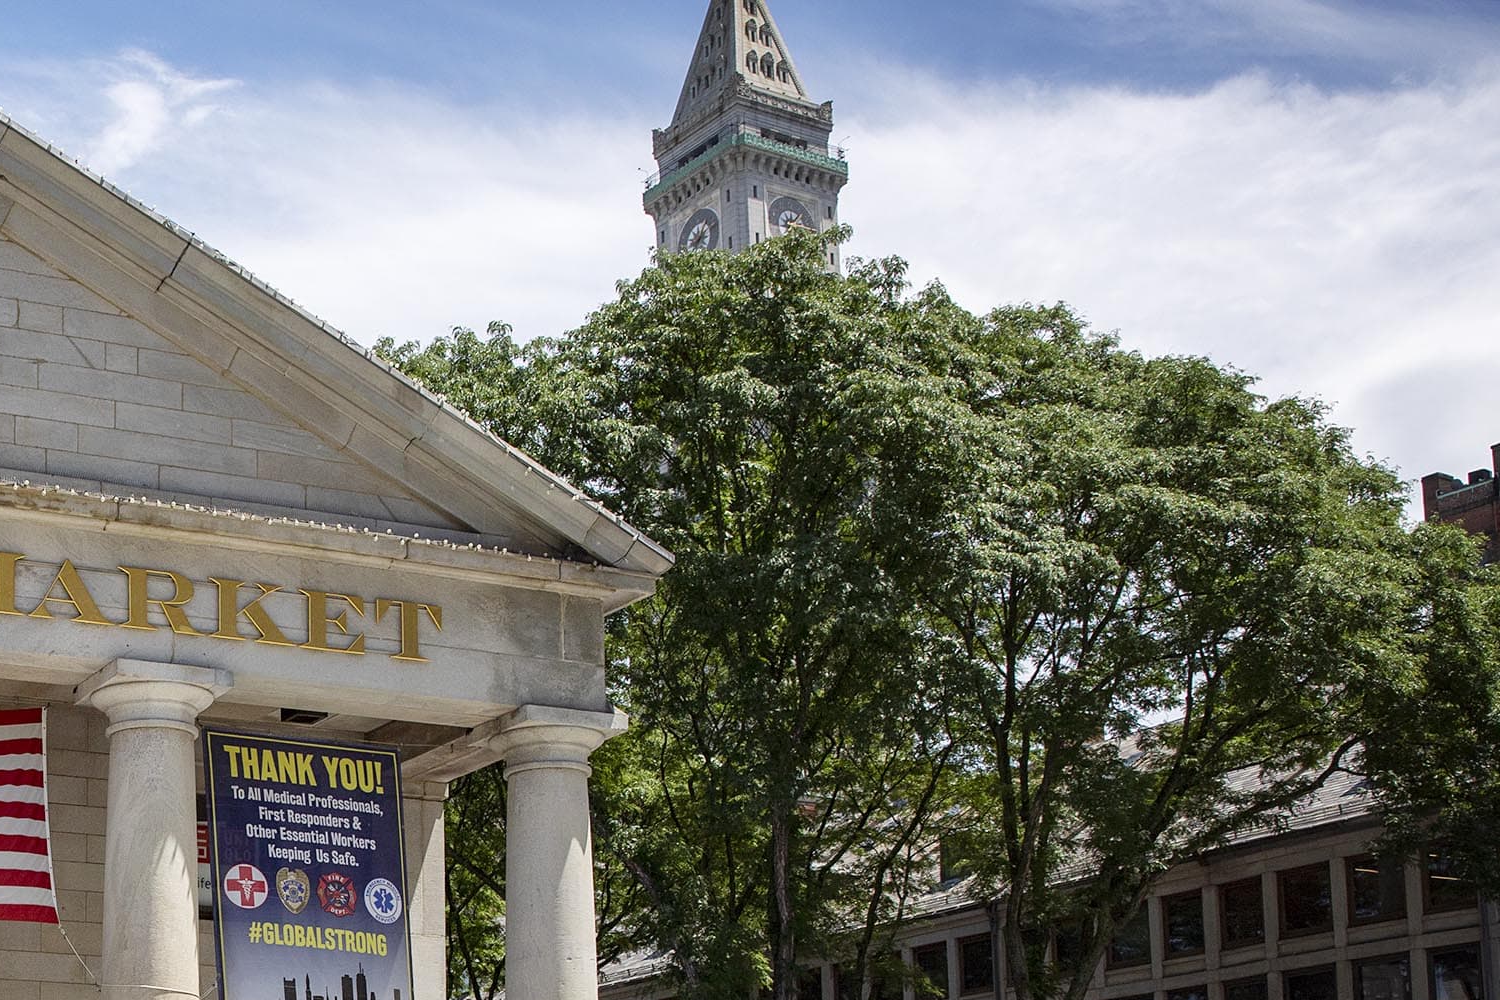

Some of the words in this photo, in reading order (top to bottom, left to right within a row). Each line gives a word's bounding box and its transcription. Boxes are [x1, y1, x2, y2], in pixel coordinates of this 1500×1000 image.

[223, 745, 317, 786] THANK
[322, 755, 384, 794] YOU!
[231, 785, 245, 800] To
[248, 787, 261, 801] All
[263, 789, 306, 806] Medical
[308, 793, 384, 817] Professionals,
[258, 806, 285, 822] First
[287, 810, 350, 830] Responders
[352, 816, 362, 831] &
[246, 823, 278, 840] Other
[279, 826, 329, 845] Essential
[330, 831, 377, 850] Workers
[267, 844, 312, 865] Keeping
[316, 849, 330, 864] Us
[331, 851, 360, 867] Safe.
[327, 874, 345, 883] FIRE
[249, 921, 387, 957] #GLOBALSTRONG
